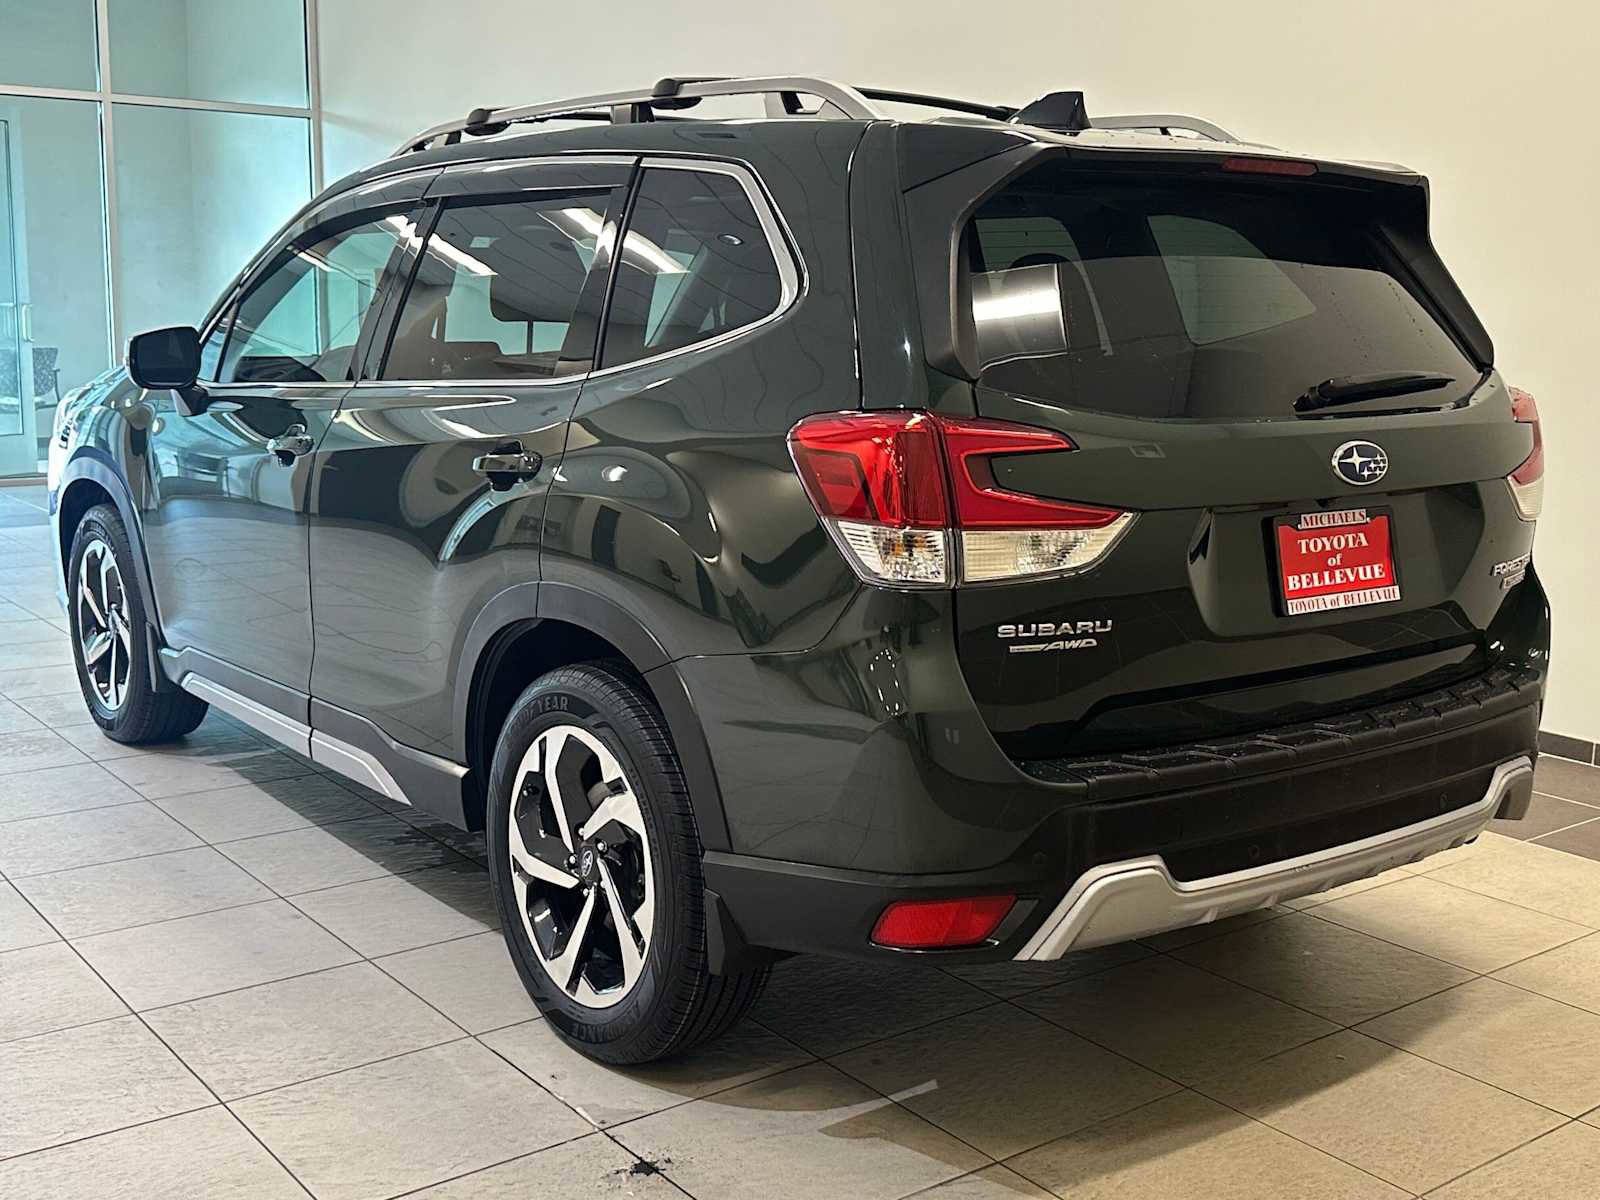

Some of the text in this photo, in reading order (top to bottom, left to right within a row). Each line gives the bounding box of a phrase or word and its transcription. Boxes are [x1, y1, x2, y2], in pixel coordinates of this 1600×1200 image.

[1302, 510, 1366, 526] MICHAELS
[1297, 532, 1369, 554] TOYOTA
[1327, 553, 1343, 567] of
[1287, 564, 1385, 591] BELLEVUE
[1289, 587, 1398, 613] TOYOTA of BELLEVUE
[997, 619, 1113, 638] SUBARU
[1043, 639, 1097, 651] AWD
